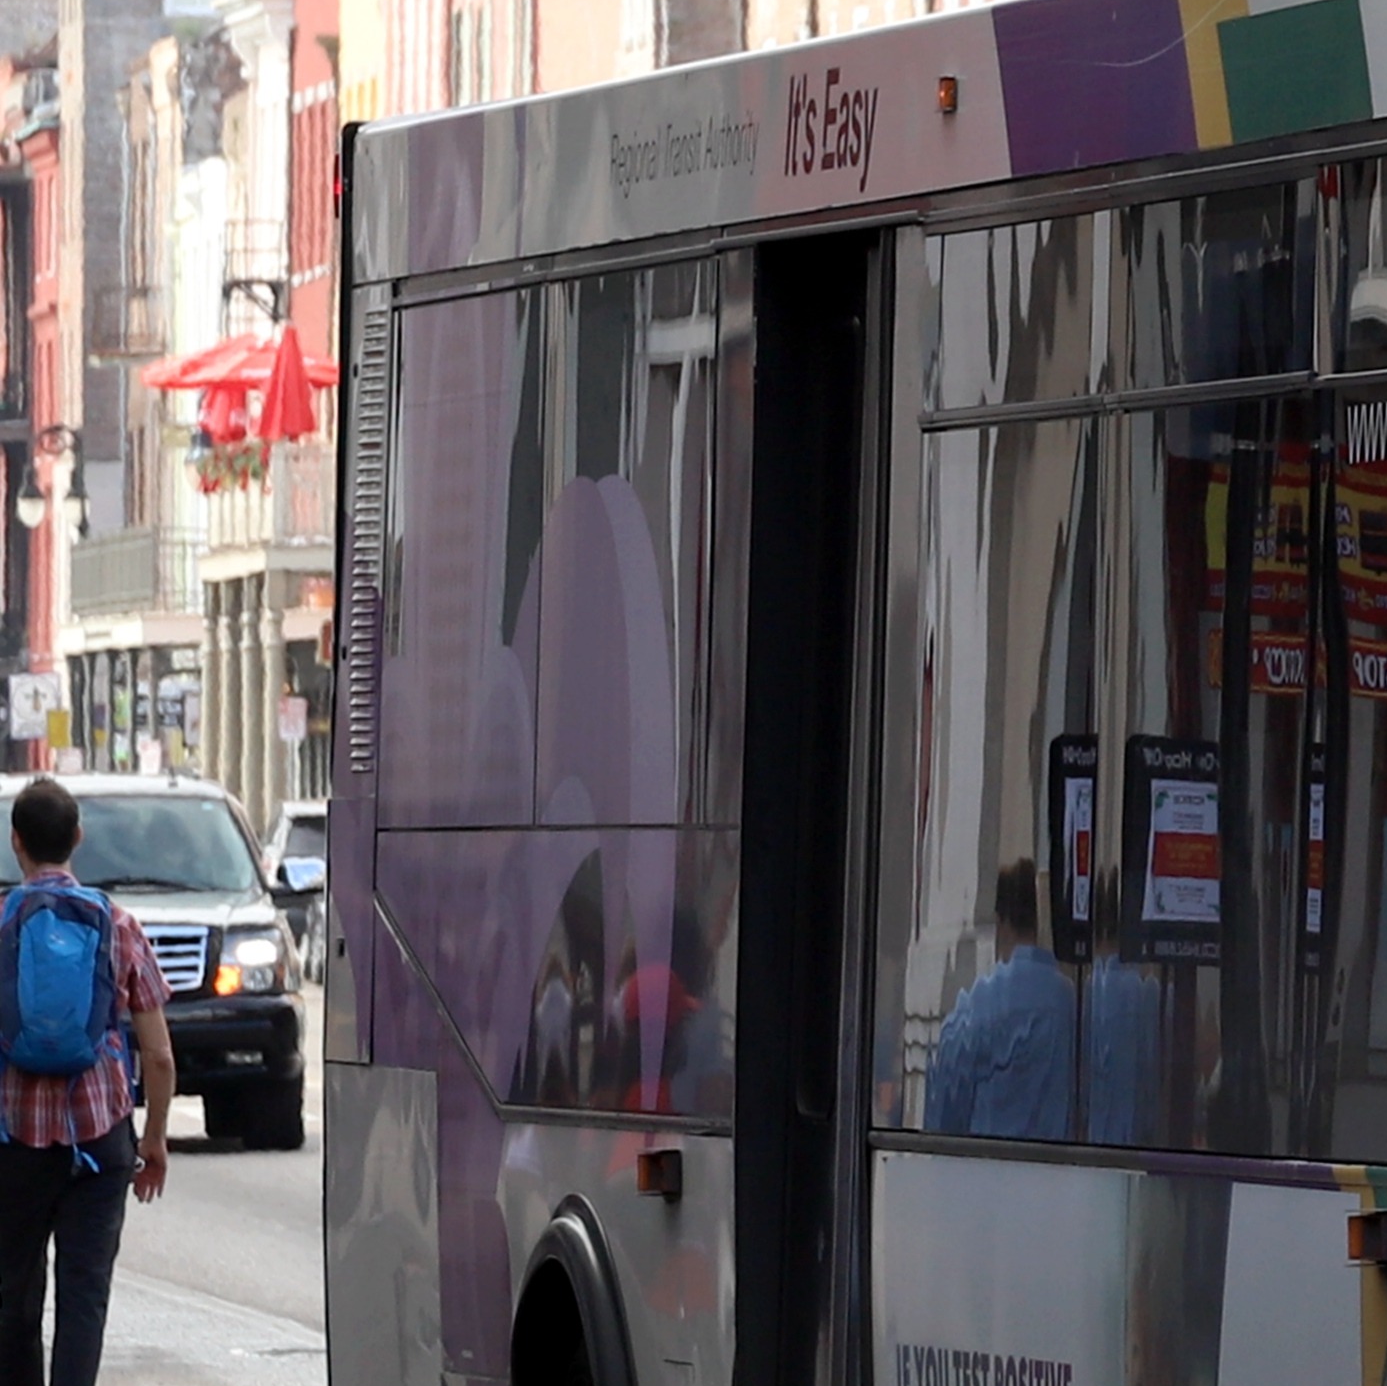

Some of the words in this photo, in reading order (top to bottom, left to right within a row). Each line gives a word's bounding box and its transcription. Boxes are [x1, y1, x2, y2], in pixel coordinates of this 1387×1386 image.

[610, 125, 661, 198] Regional
[663, 119, 703, 178] Transit
[703, 108, 760, 175] Authority
[784, 73, 816, 177] It's
[821, 67, 878, 193] Easy
